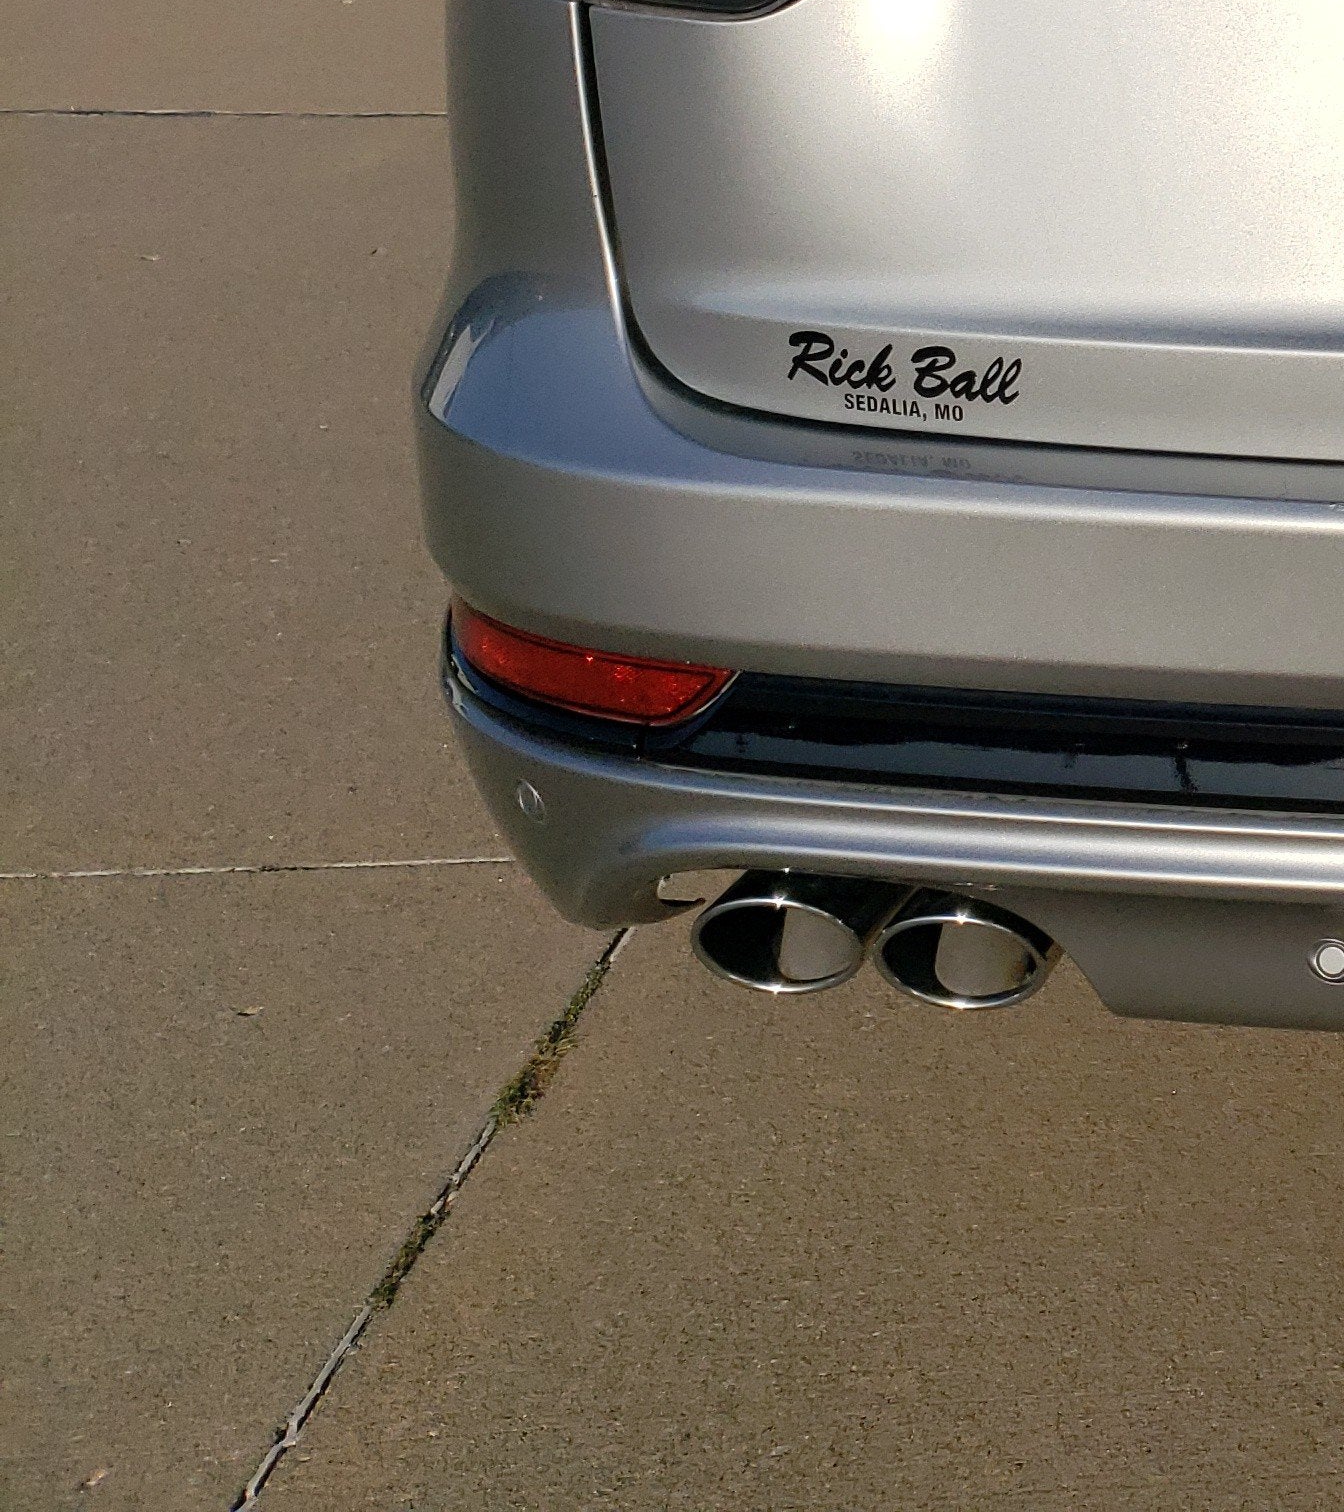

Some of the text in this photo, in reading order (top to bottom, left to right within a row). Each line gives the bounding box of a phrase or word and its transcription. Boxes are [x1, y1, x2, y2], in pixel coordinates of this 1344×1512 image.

[787, 330, 1022, 405] Rick Ball
[844, 393, 964, 422] SEDALIA, MO
